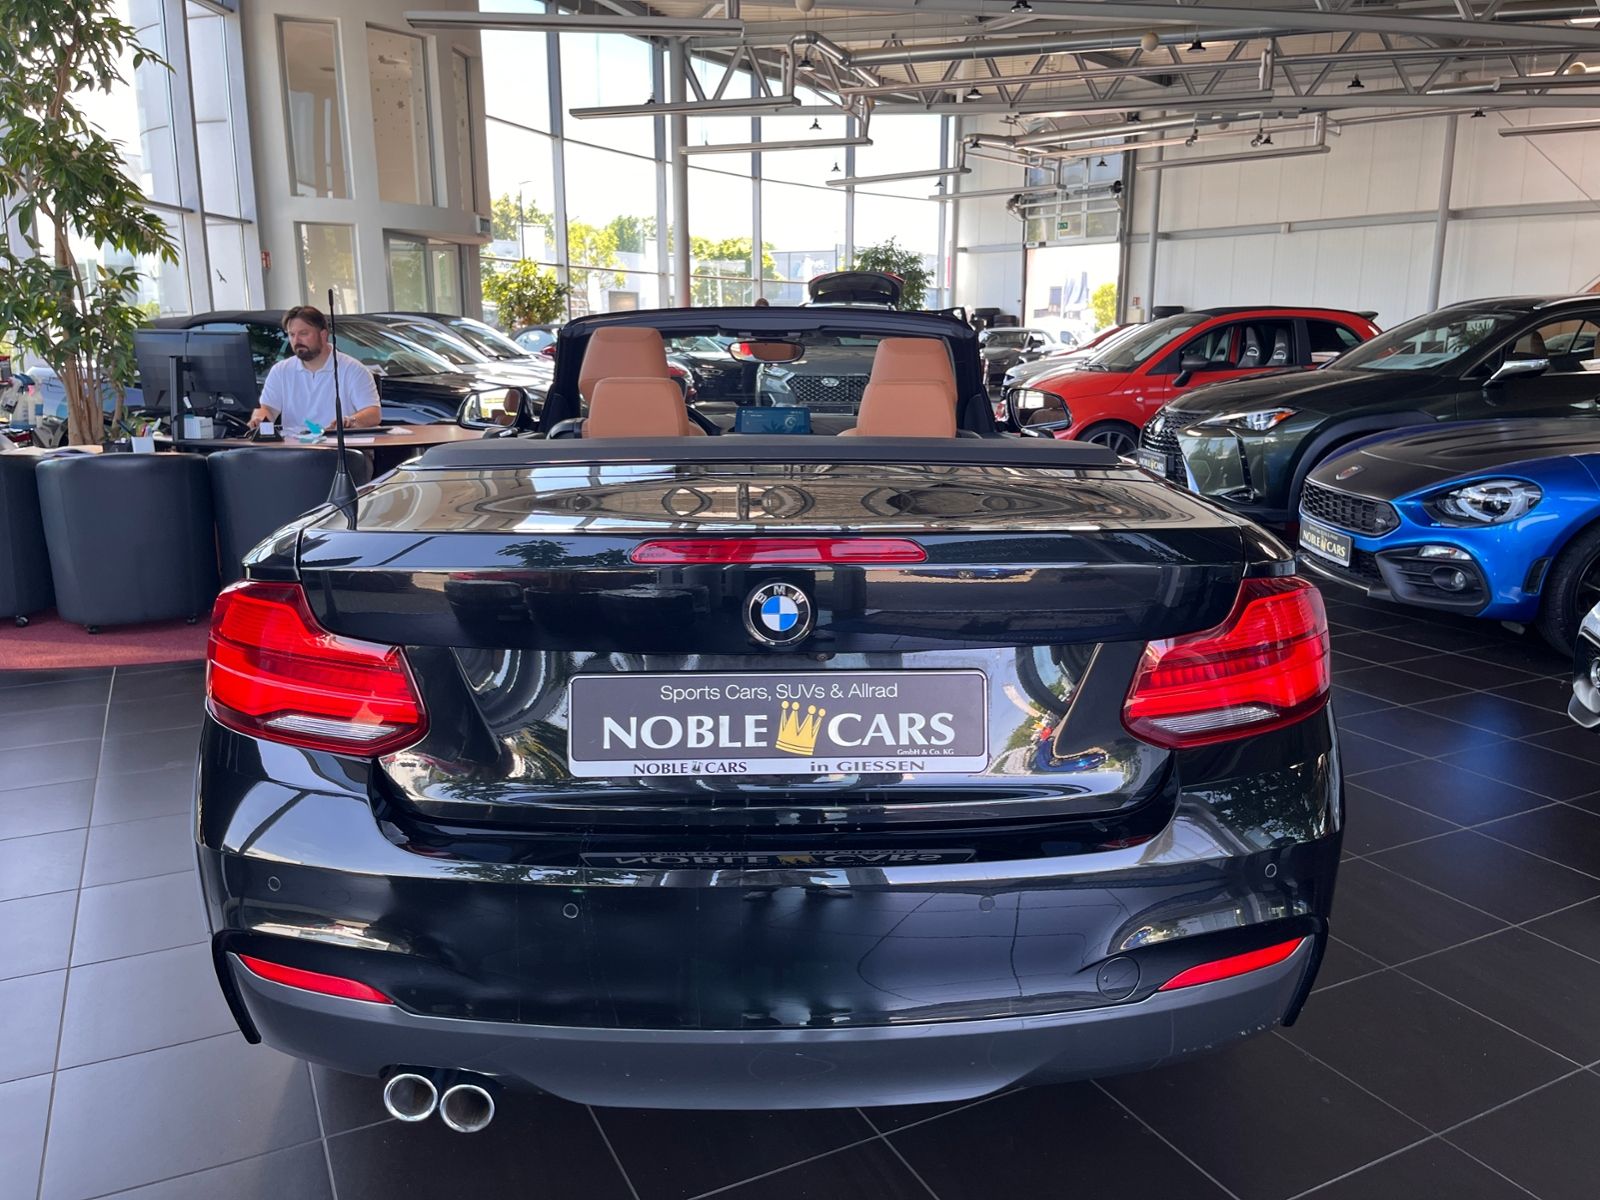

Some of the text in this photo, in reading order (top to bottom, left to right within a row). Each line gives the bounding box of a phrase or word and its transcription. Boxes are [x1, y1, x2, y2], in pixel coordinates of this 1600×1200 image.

[1302, 529, 1320, 547] NOBLE
[1326, 541, 1346, 558] CARS
[755, 585, 804, 605] BMW
[660, 683, 898, 703] Sports Cars, SUVs & Allrad
[603, 712, 956, 749] NOBLE CARS
[897, 748, 920, 756] GmbH
[929, 748, 942, 756] Co.
[943, 748, 955, 756] KG
[633, 761, 747, 775] NOBLE CARS
[810, 760, 925, 772] in GIESSEN
